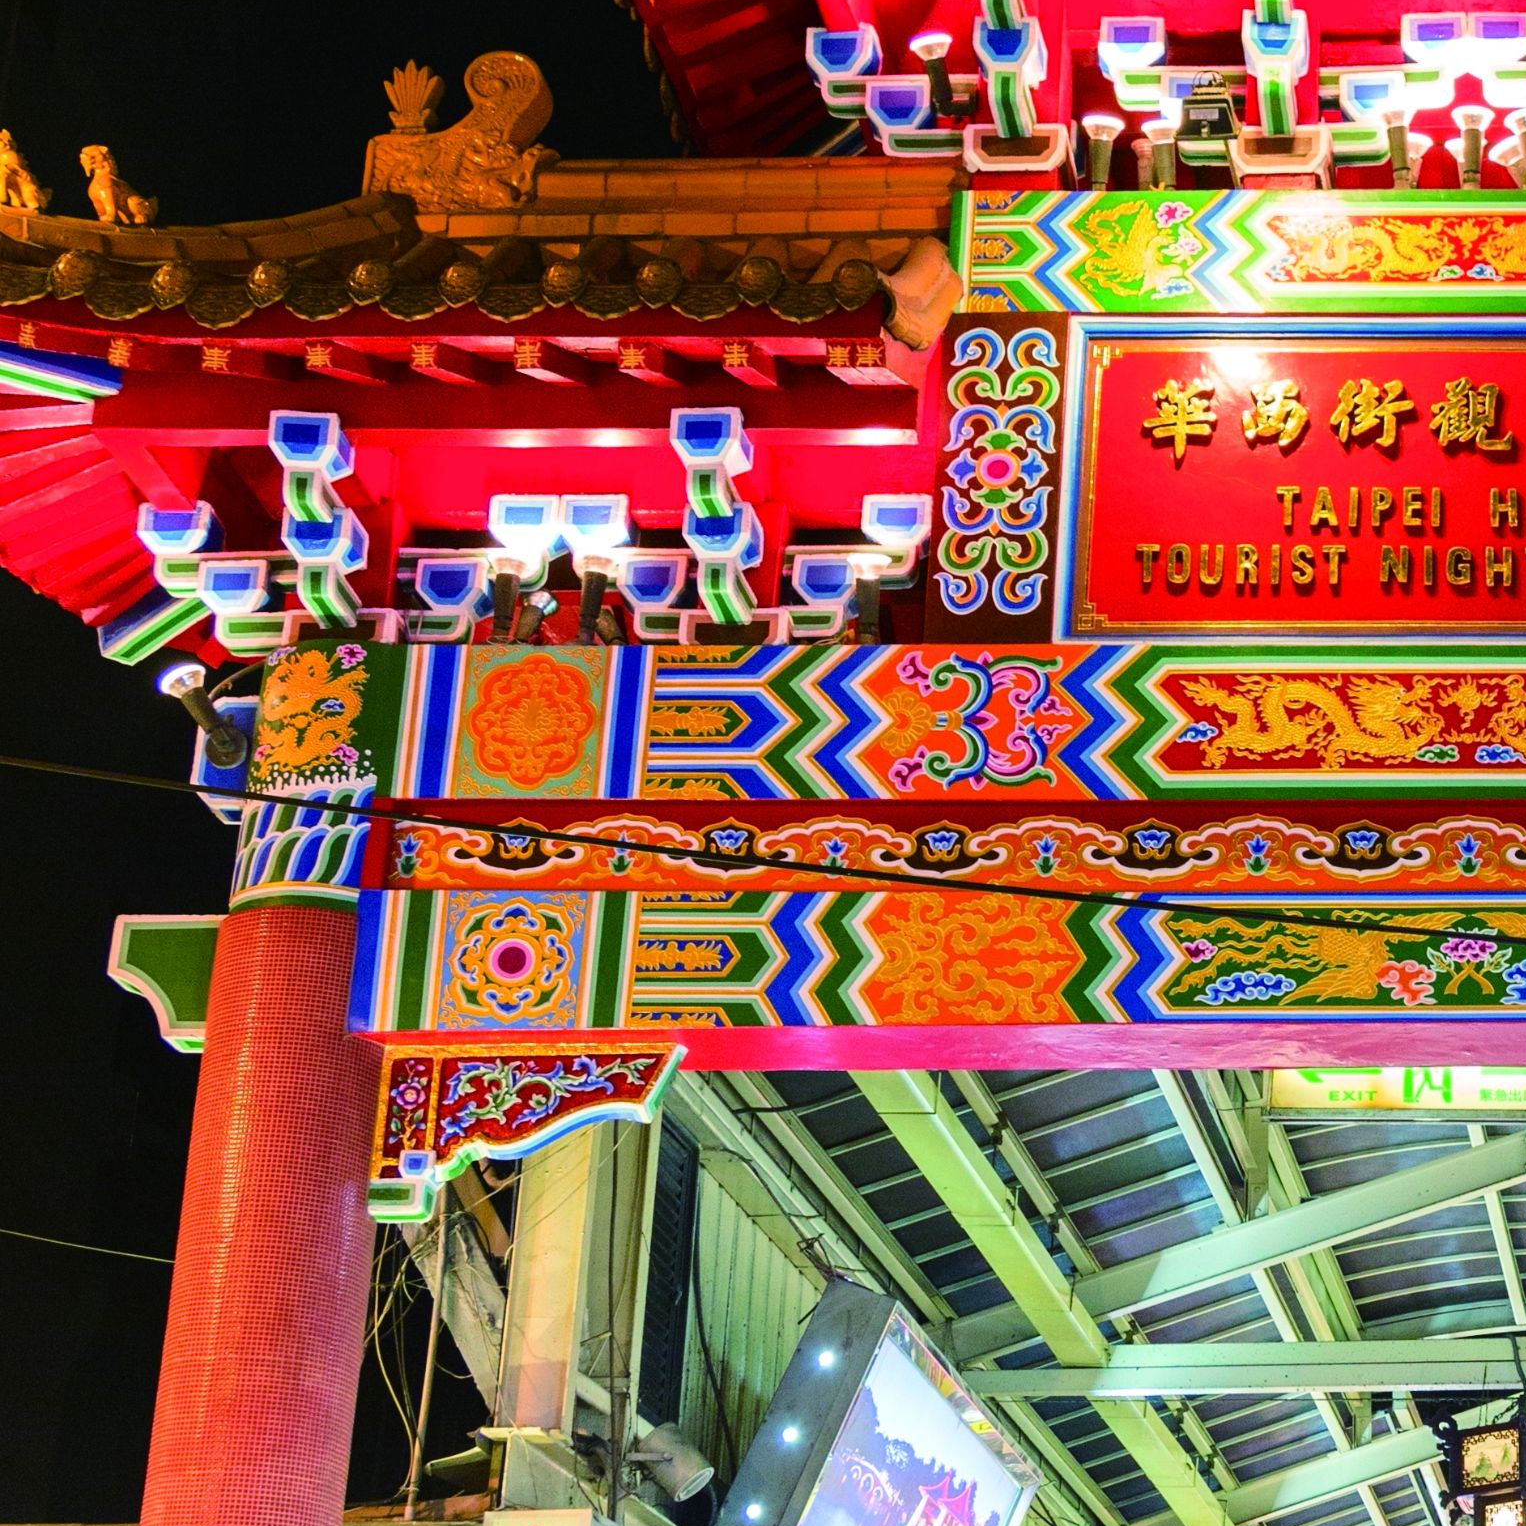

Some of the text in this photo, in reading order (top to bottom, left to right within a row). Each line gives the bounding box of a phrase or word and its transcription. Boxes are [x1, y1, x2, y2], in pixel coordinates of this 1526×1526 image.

[1275, 485, 1441, 527] TAIPEI
[1136, 543, 1346, 585] TOURIST
[1328, 1090, 1378, 1102] EXIT
